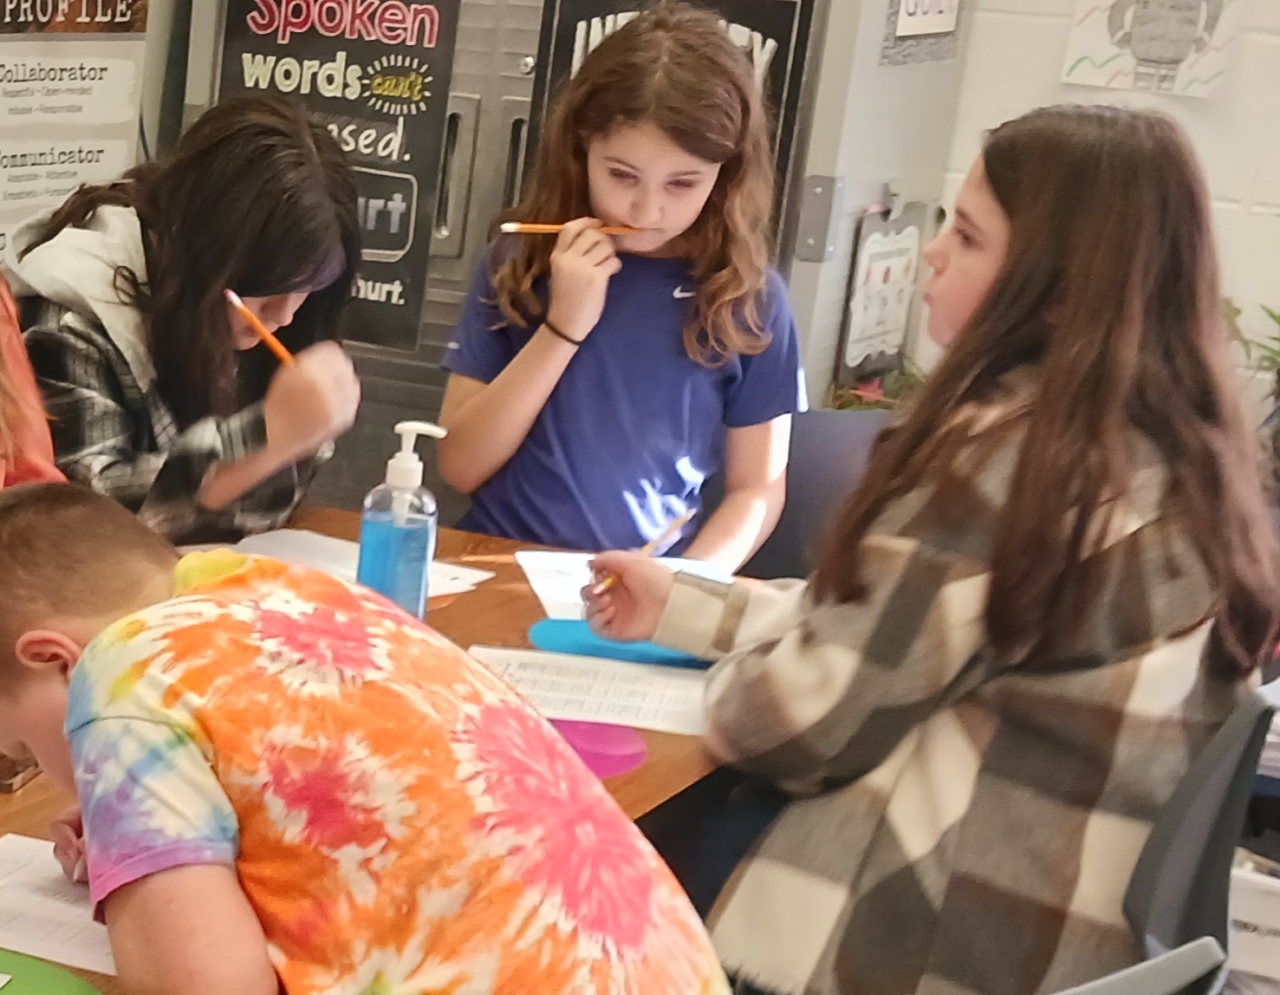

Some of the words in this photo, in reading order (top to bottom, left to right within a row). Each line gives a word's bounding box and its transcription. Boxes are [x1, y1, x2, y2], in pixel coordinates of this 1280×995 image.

[3, 0, 132, 23] PROFILE
[246, 0, 440, 48] Spoken
[241, 51, 362, 100] words
